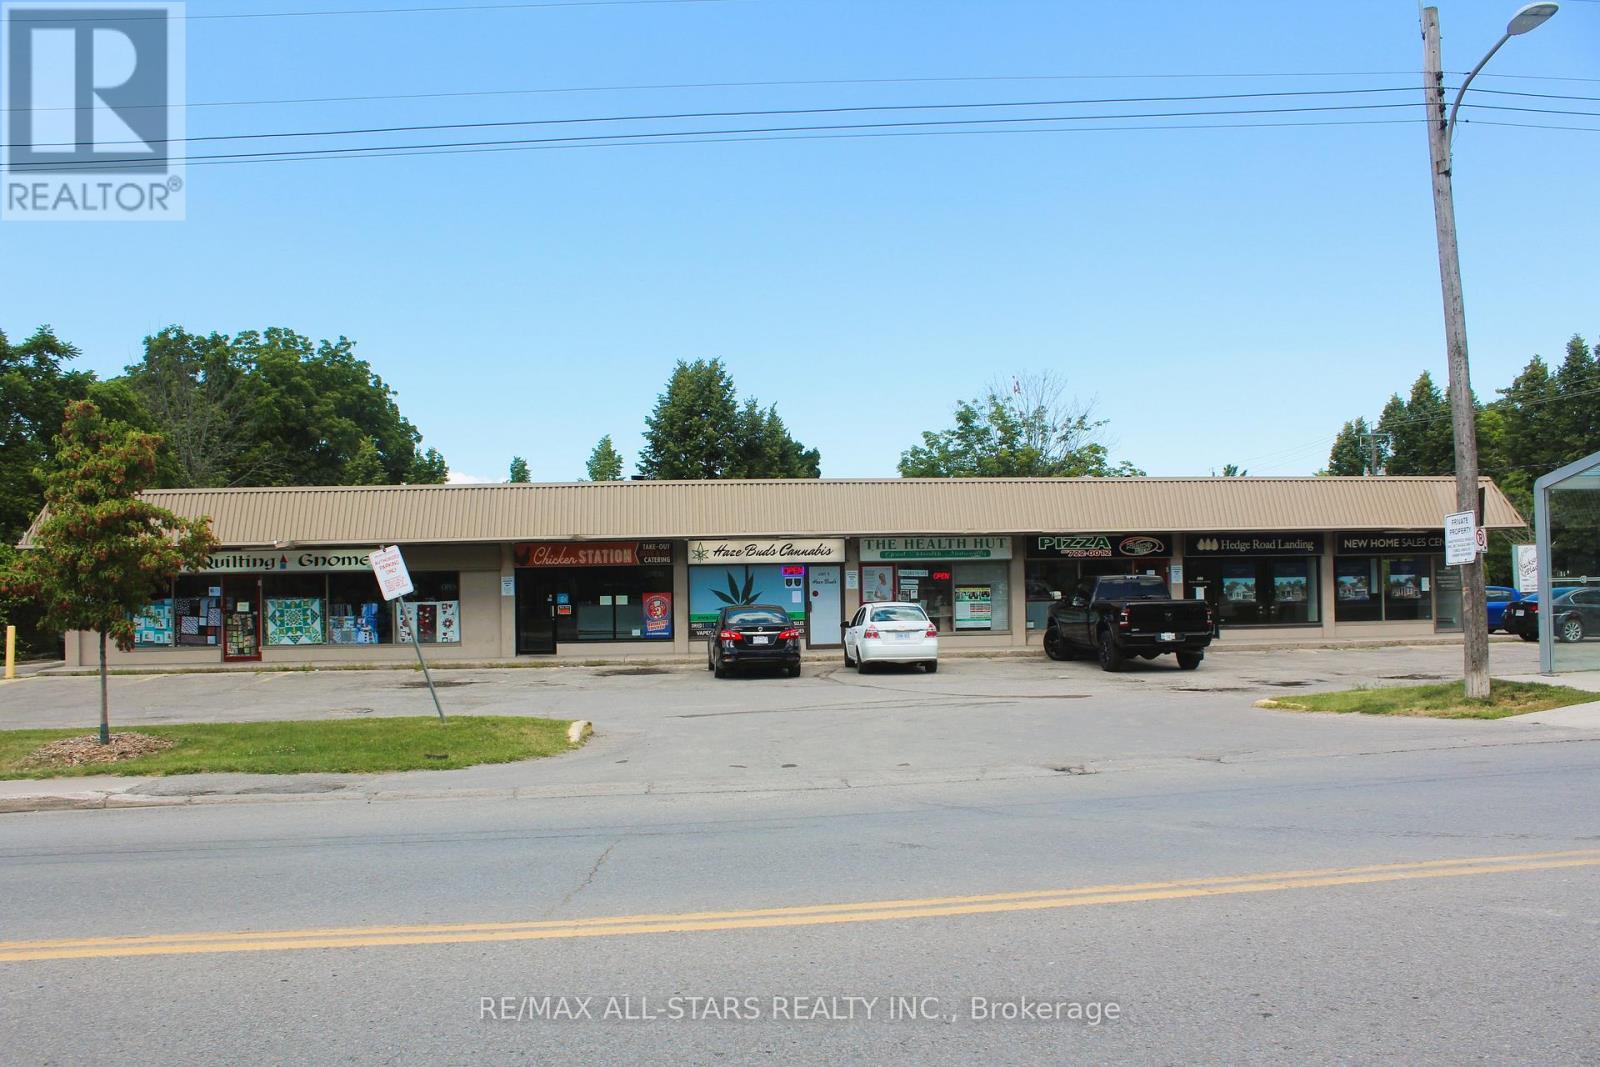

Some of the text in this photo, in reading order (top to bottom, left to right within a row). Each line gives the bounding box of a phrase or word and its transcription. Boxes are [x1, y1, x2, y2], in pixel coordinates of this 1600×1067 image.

[864, 537, 1006, 550] THE HEALTH HUT
[1038, 536, 1111, 550] PIZZA
[1221, 539, 1314, 552] Hedge Road Landing
[1344, 539, 1367, 548] NEW
[1370, 538, 1399, 548] HOME
[1401, 537, 1426, 547] SALES
[533, 546, 633, 565] Chicken STATION
[713, 542, 833, 557] Haze Buds Cannabis
[933, 571, 951, 580] OPEN
